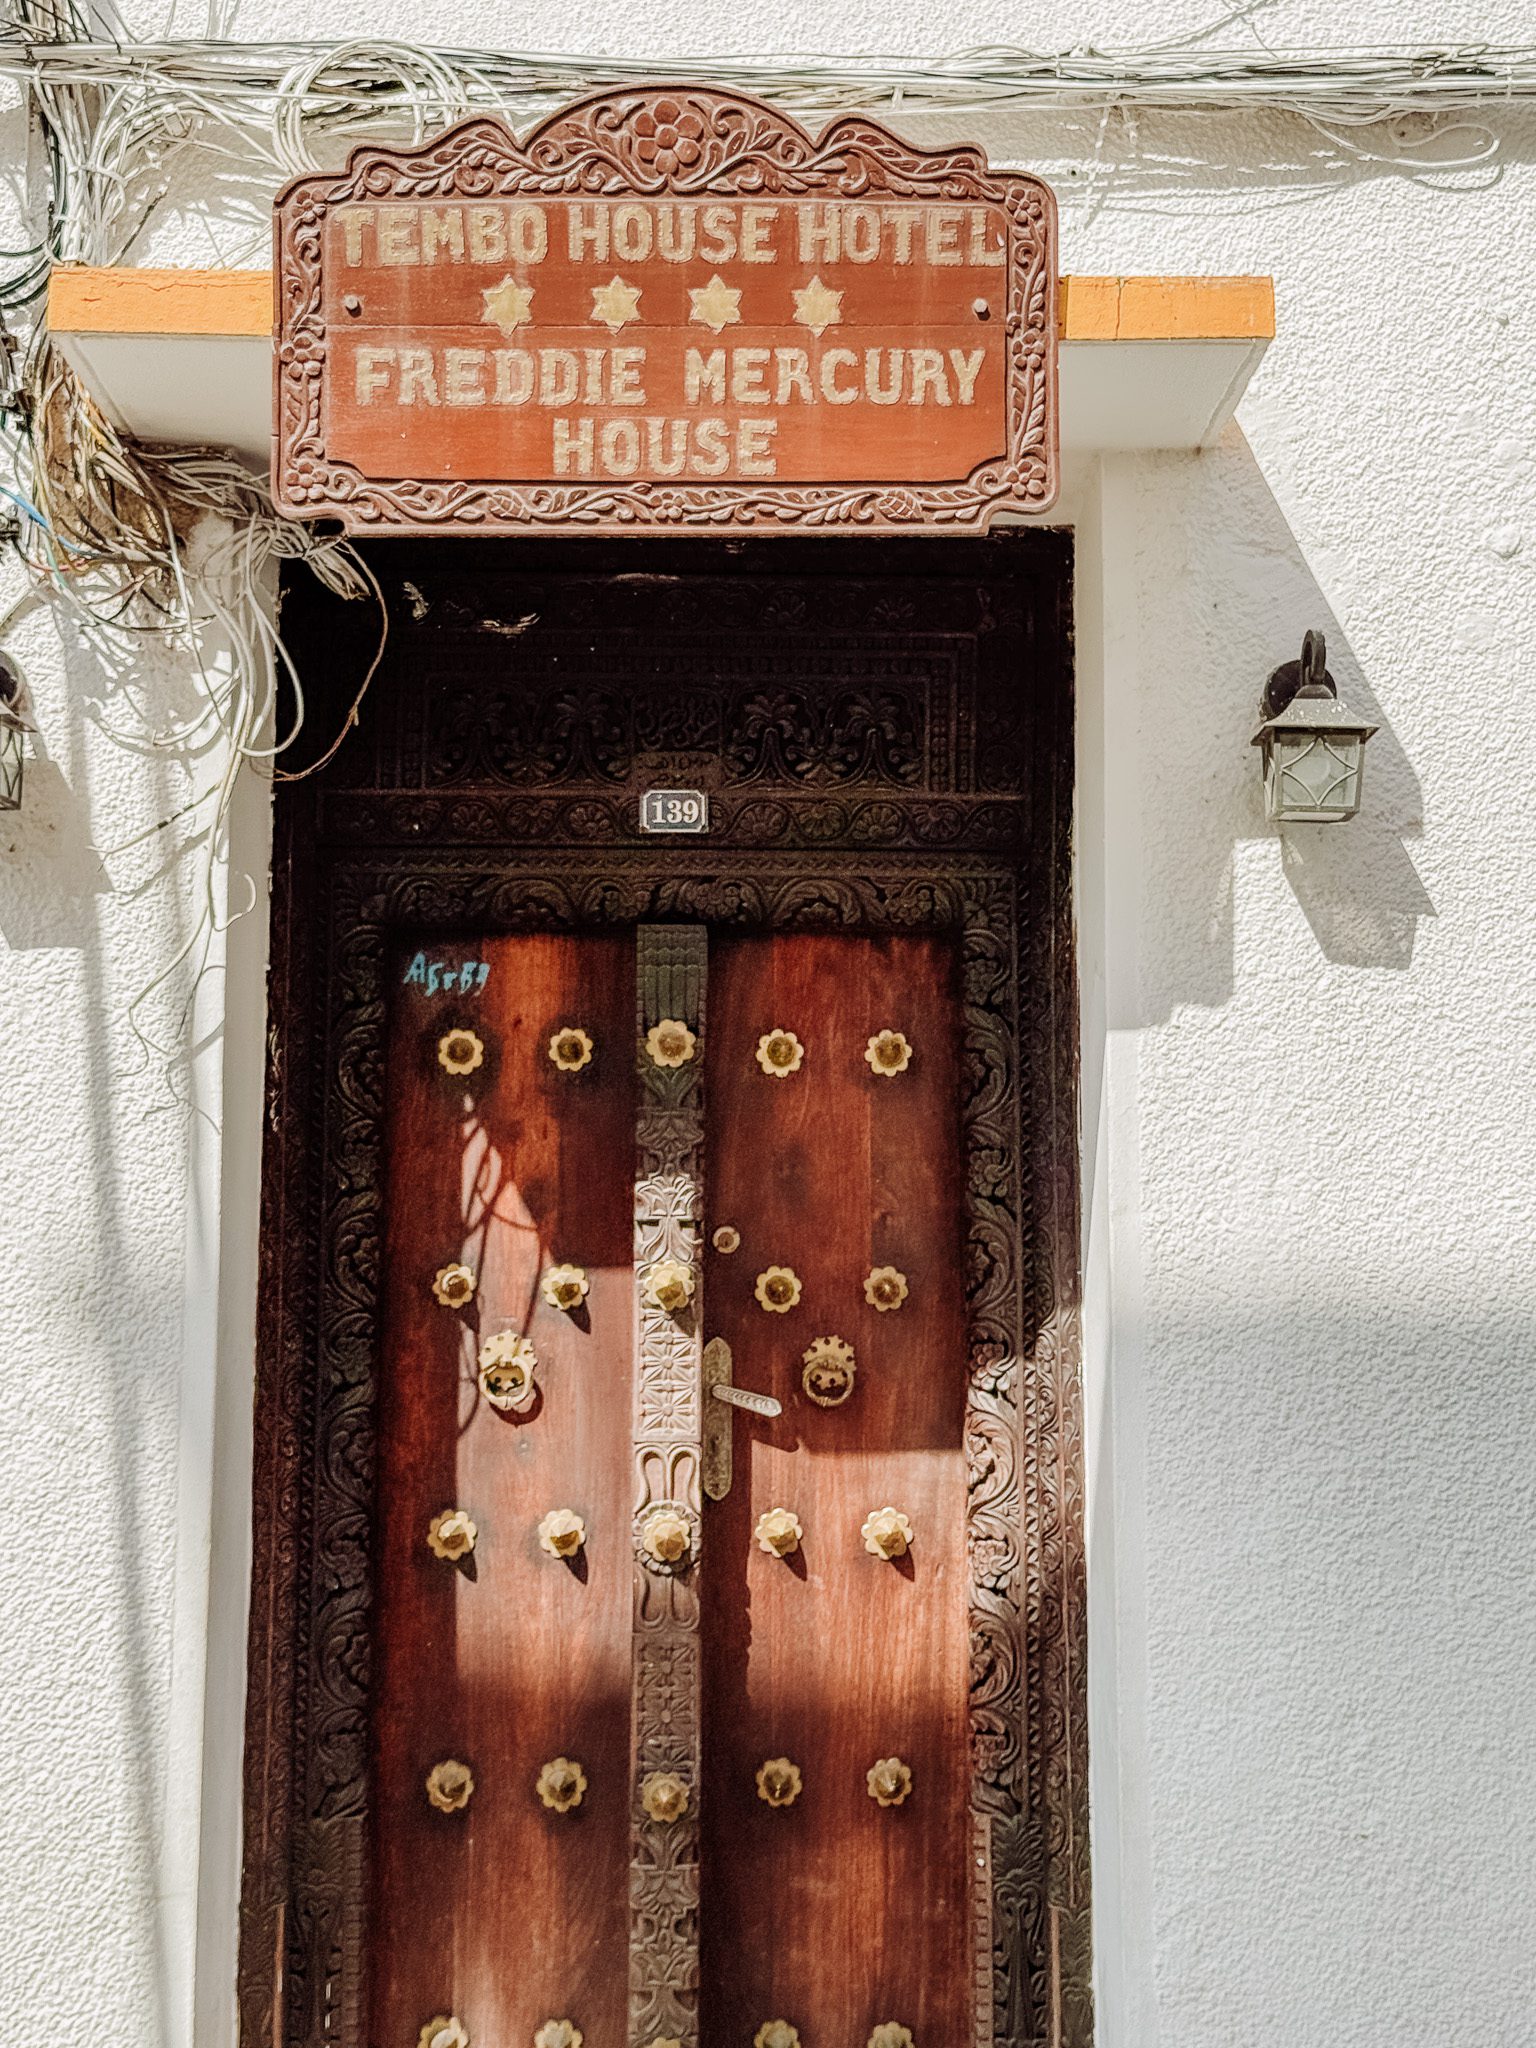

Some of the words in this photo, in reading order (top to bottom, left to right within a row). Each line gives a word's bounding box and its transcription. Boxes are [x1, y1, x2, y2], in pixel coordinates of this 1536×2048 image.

[334, 206, 548, 267] TEMBO
[568, 203, 779, 264] HOUSE
[797, 204, 1006, 267] HOTEL
[355, 346, 647, 406] FREDDIE
[685, 347, 986, 406] MERCURY
[553, 416, 777, 476] HOUSE
[652, 799, 699, 824] 139
